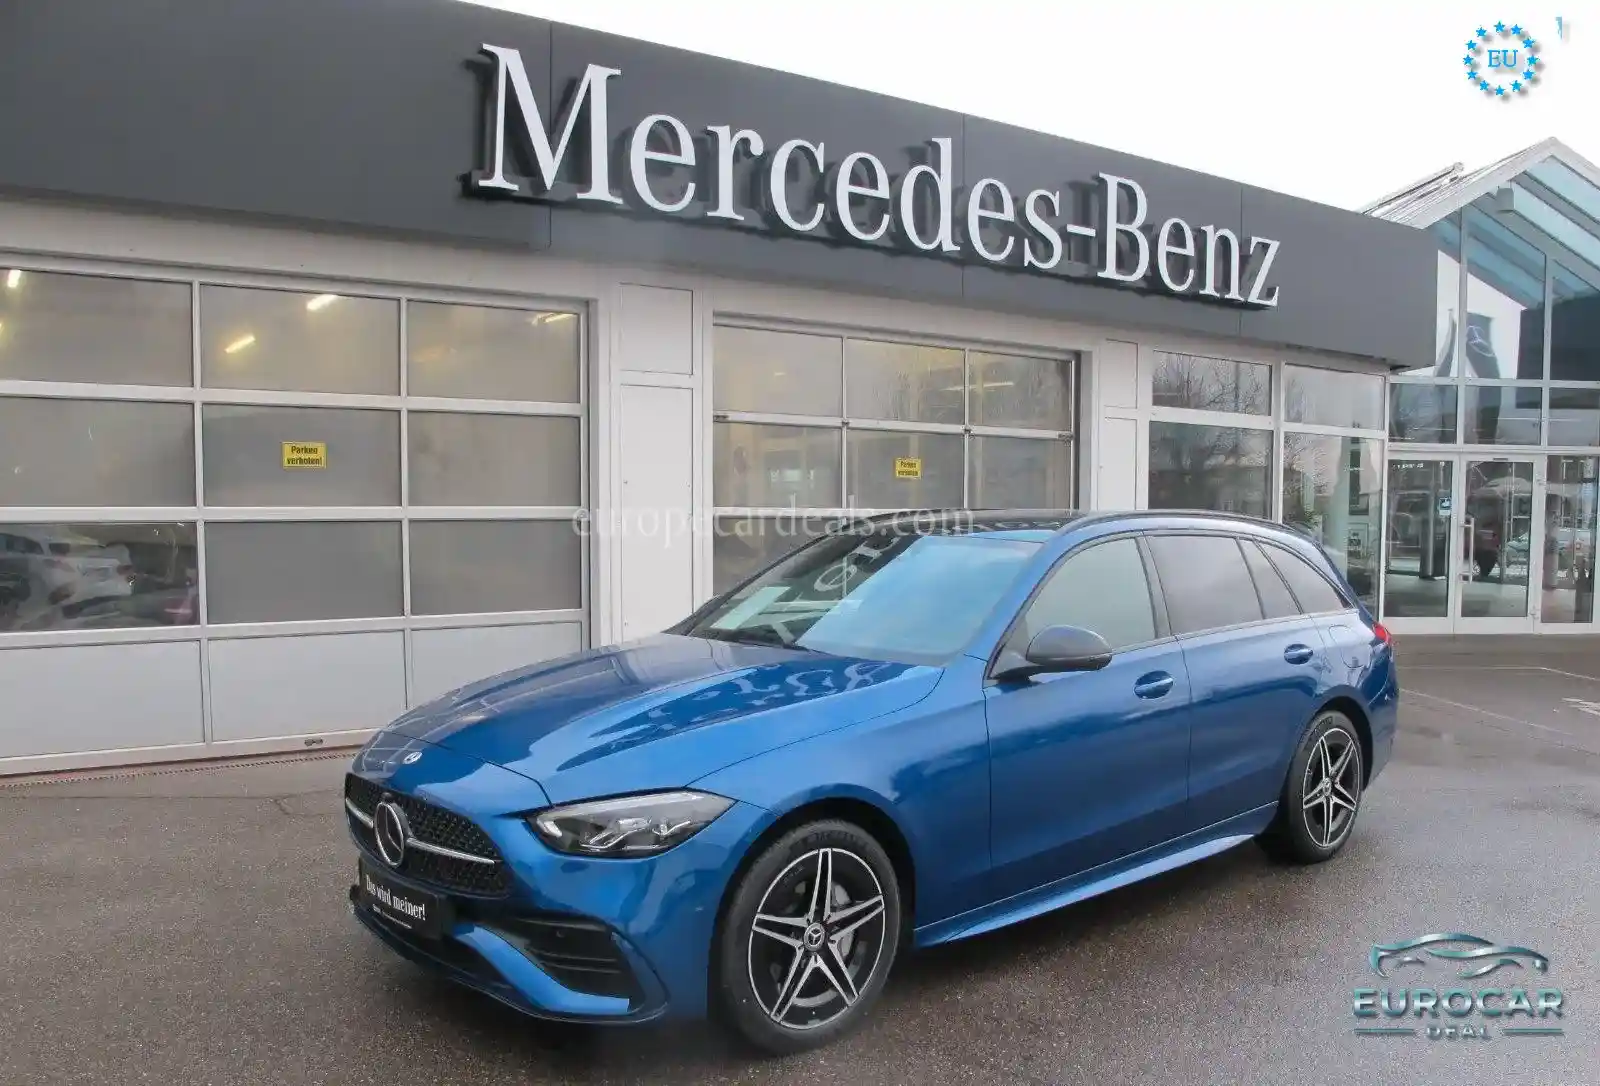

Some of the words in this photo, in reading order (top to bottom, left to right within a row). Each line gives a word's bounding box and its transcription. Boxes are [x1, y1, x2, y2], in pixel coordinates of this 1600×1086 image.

[477, 43, 1281, 308] Mercedes-Benz
[290, 445, 318, 455] Parken
[392, 895, 426, 921] meiner!
